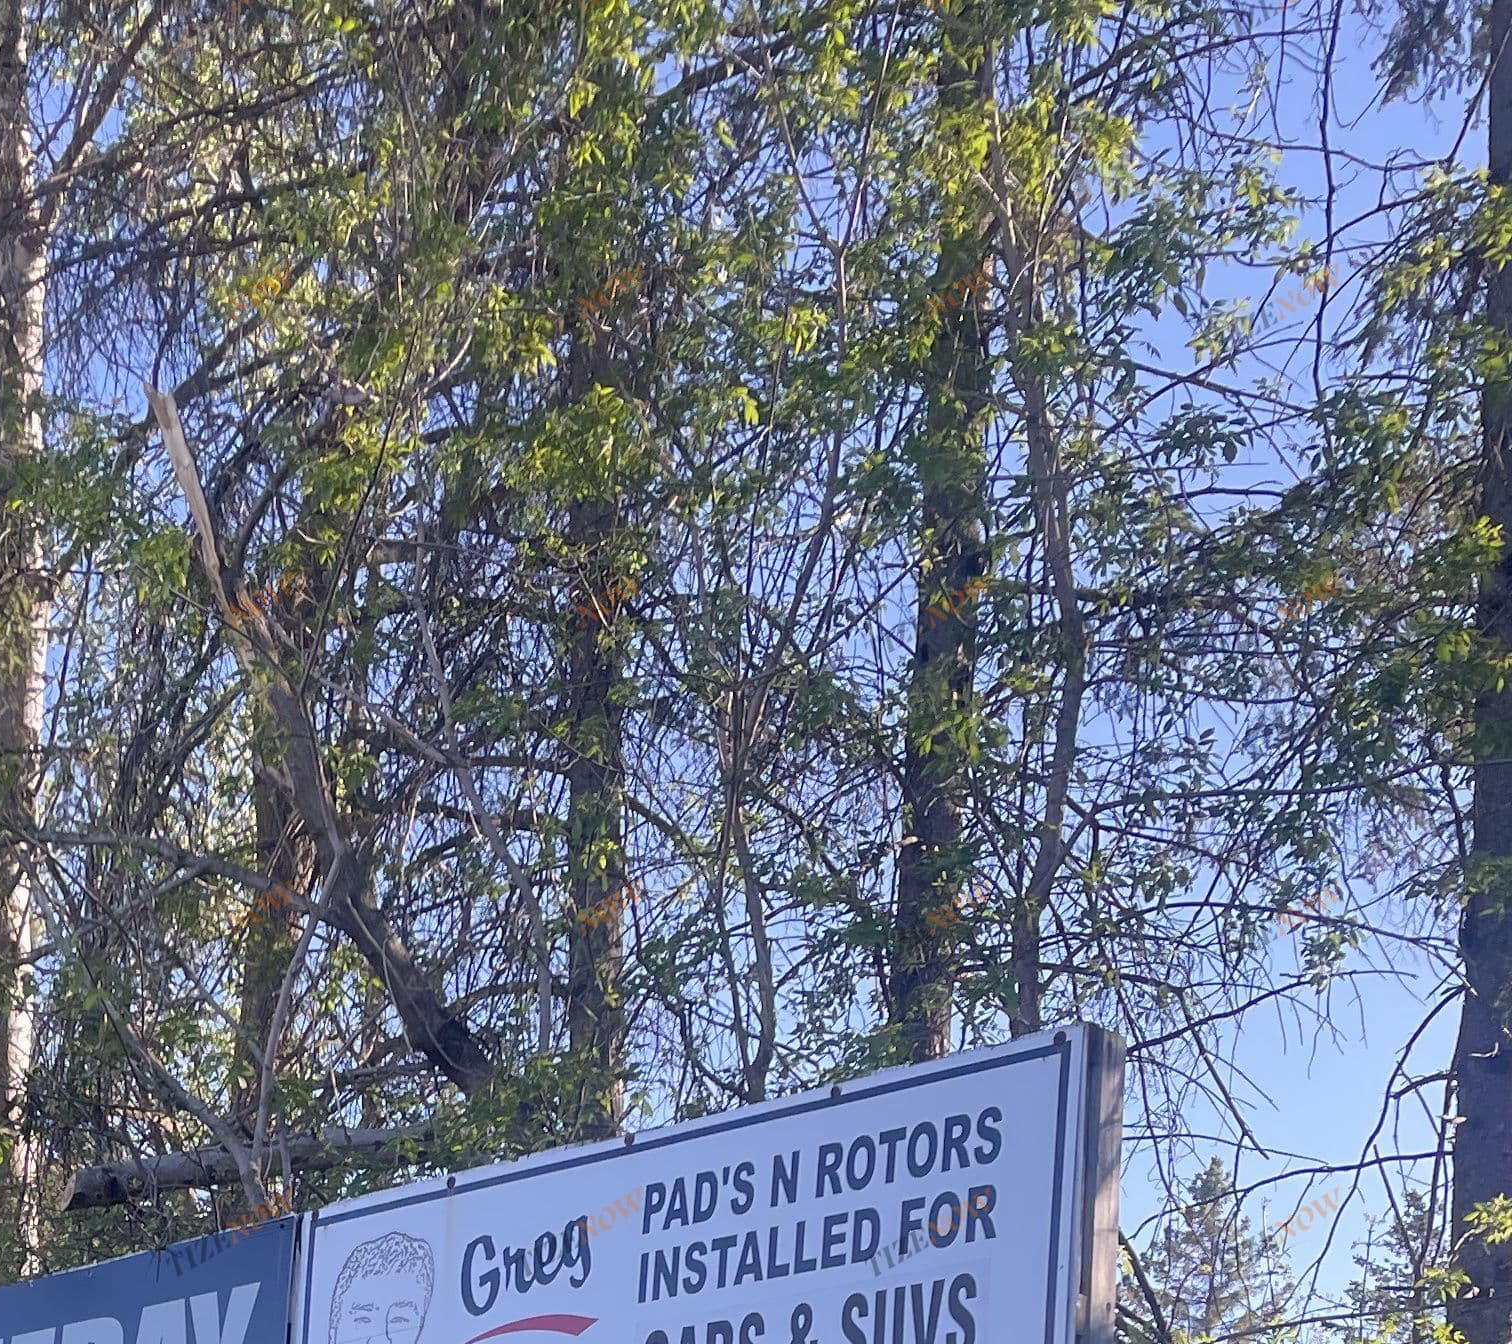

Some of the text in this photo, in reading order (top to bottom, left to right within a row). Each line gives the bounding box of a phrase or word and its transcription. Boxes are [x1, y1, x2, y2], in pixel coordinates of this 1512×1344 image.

[642, 1161, 755, 1235] PAD'S
[770, 1150, 800, 1207] N
[815, 1106, 1002, 1198] ROTORS
[461, 1215, 591, 1316] Greg
[638, 1207, 881, 1303] INSTALLED
[898, 1184, 997, 1255] FOR
